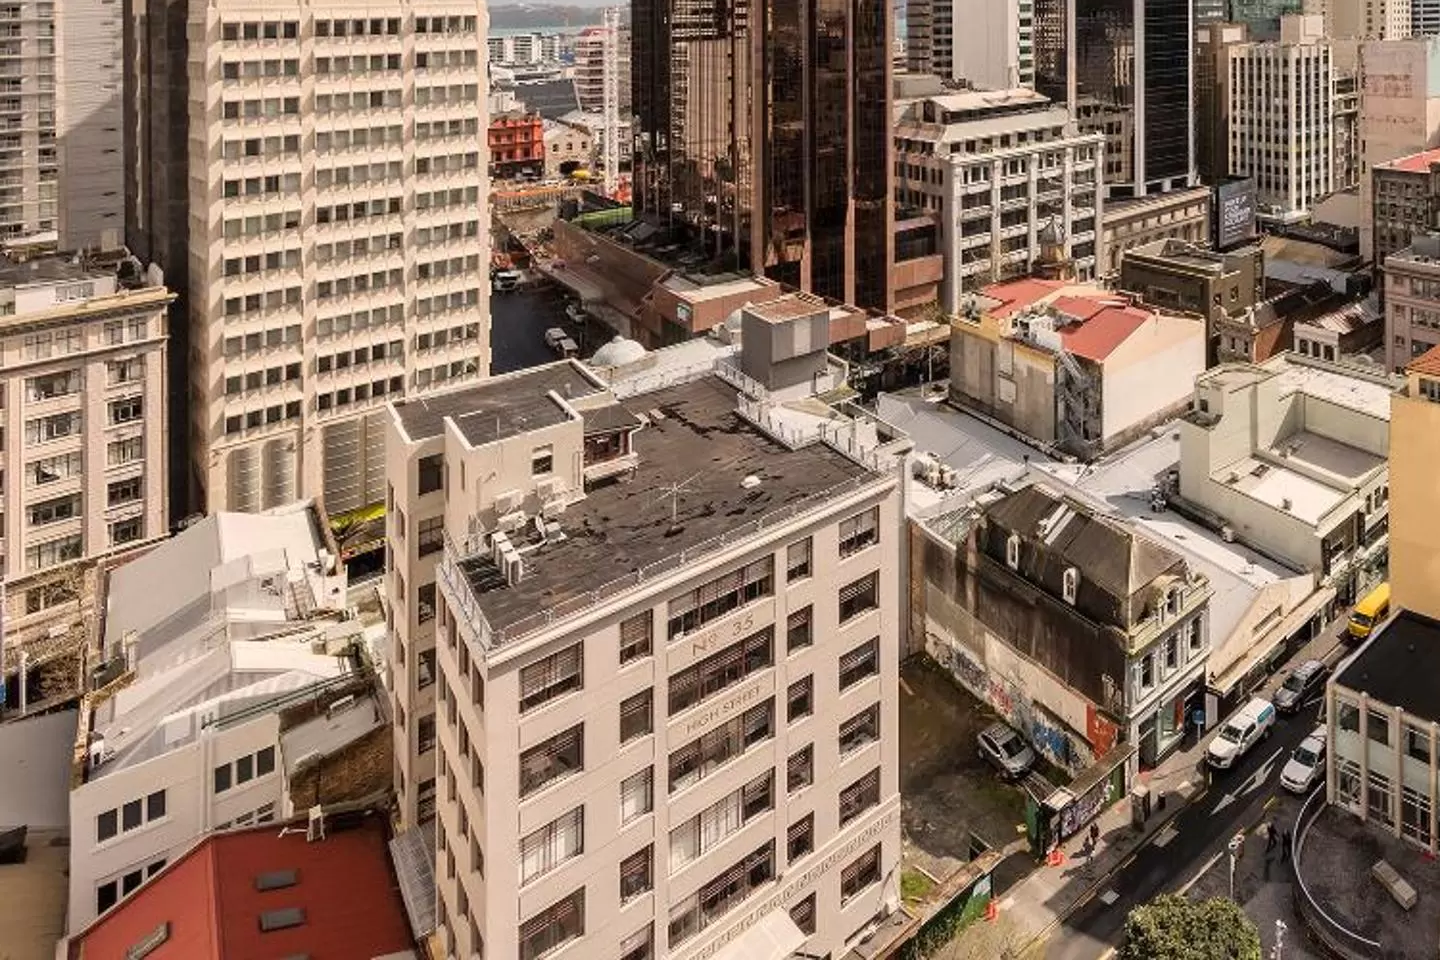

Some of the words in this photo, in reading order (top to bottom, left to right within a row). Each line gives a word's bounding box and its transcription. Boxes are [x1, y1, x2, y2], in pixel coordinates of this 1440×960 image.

[732, 611, 754, 636] 35
[686, 708, 718, 734] HIGH
[723, 685, 760, 713] STREET
